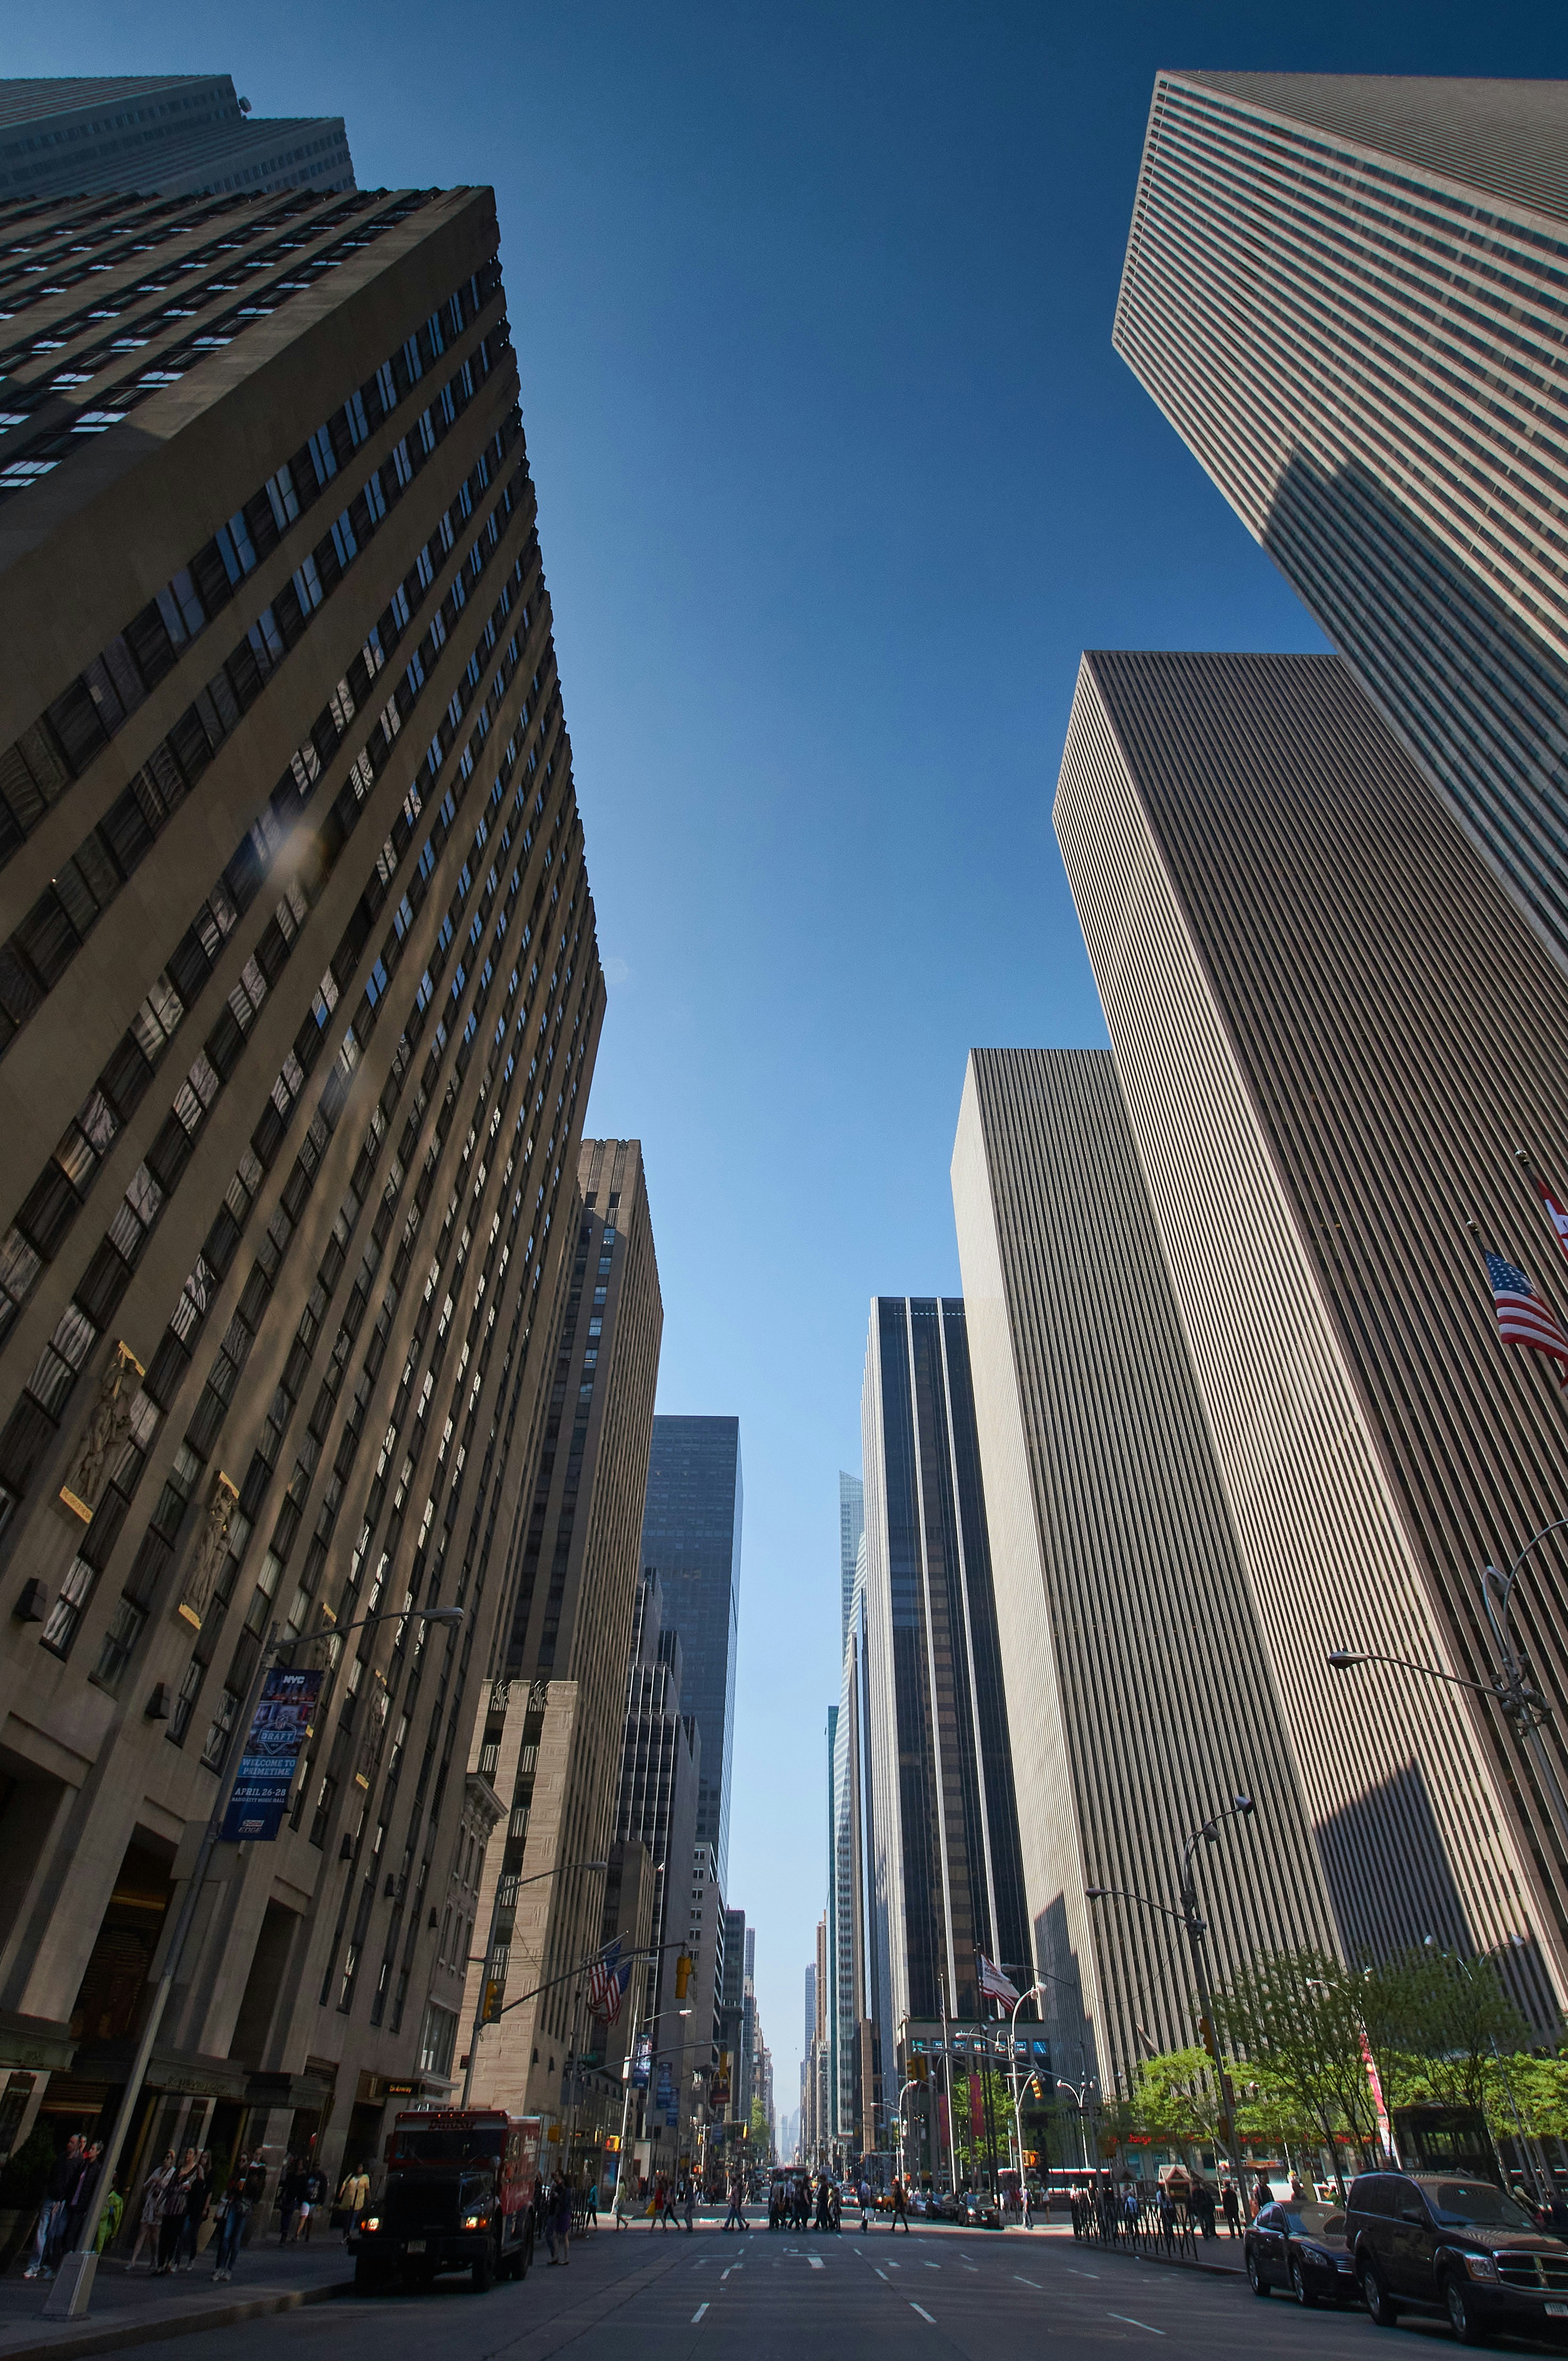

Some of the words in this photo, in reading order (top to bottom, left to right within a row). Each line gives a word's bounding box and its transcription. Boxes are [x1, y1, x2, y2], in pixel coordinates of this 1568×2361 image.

[283, 1675, 306, 1684] NYC
[261, 1732, 294, 1741] DRAFT
[242, 1758, 283, 1767] WELCOME
[235, 1787, 260, 1796] APRIL
